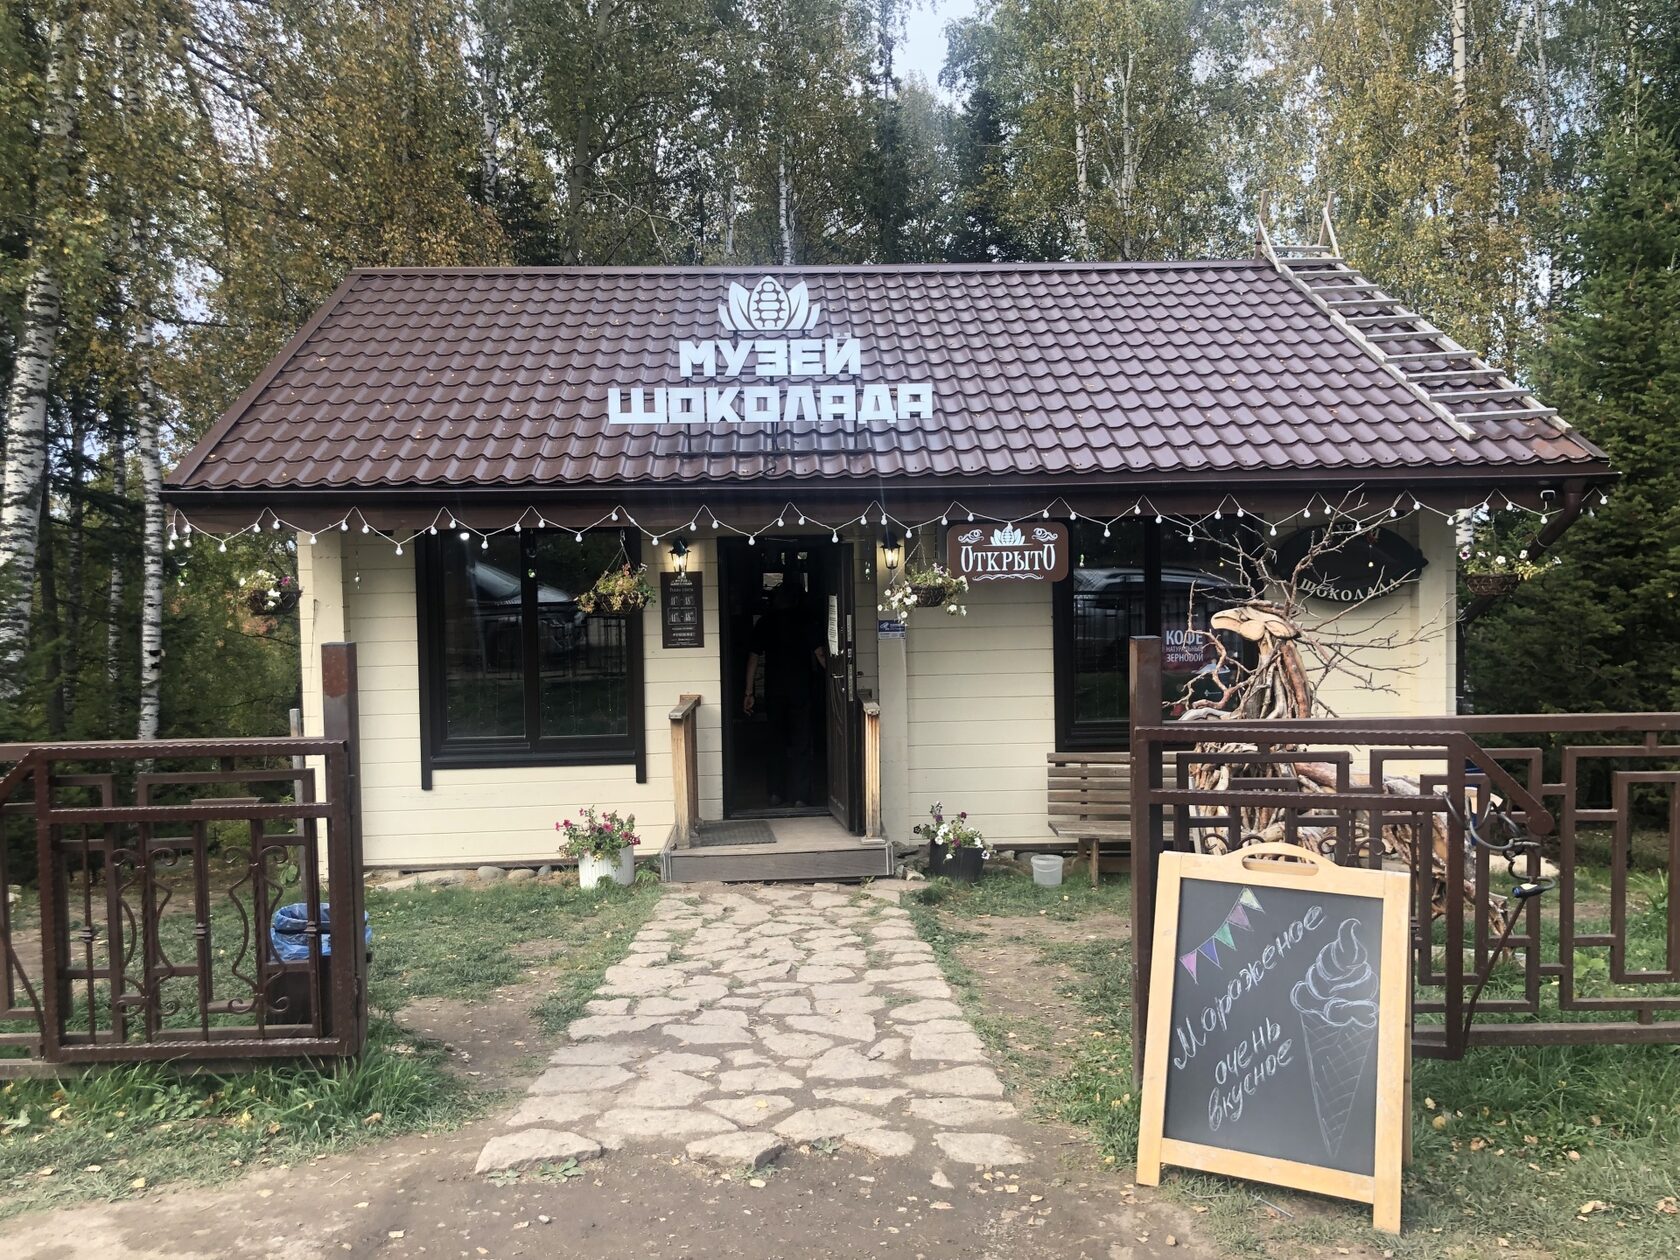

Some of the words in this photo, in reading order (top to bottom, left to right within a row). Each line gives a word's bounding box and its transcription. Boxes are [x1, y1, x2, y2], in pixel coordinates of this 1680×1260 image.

[679, 332, 862, 378] МУЗЕЙ
[608, 383, 933, 425] ШОКОЛАДА
[961, 544, 1056, 573] ОТКРЫТО
[1166, 630, 1204, 645] КОФЕ
[1166, 652, 1204, 663] ЗЕРНОВОЙ
[1174, 905, 1327, 1070] Мороженое
[1215, 1017, 1281, 1085] очень
[1208, 1038, 1294, 1131] вкусное
